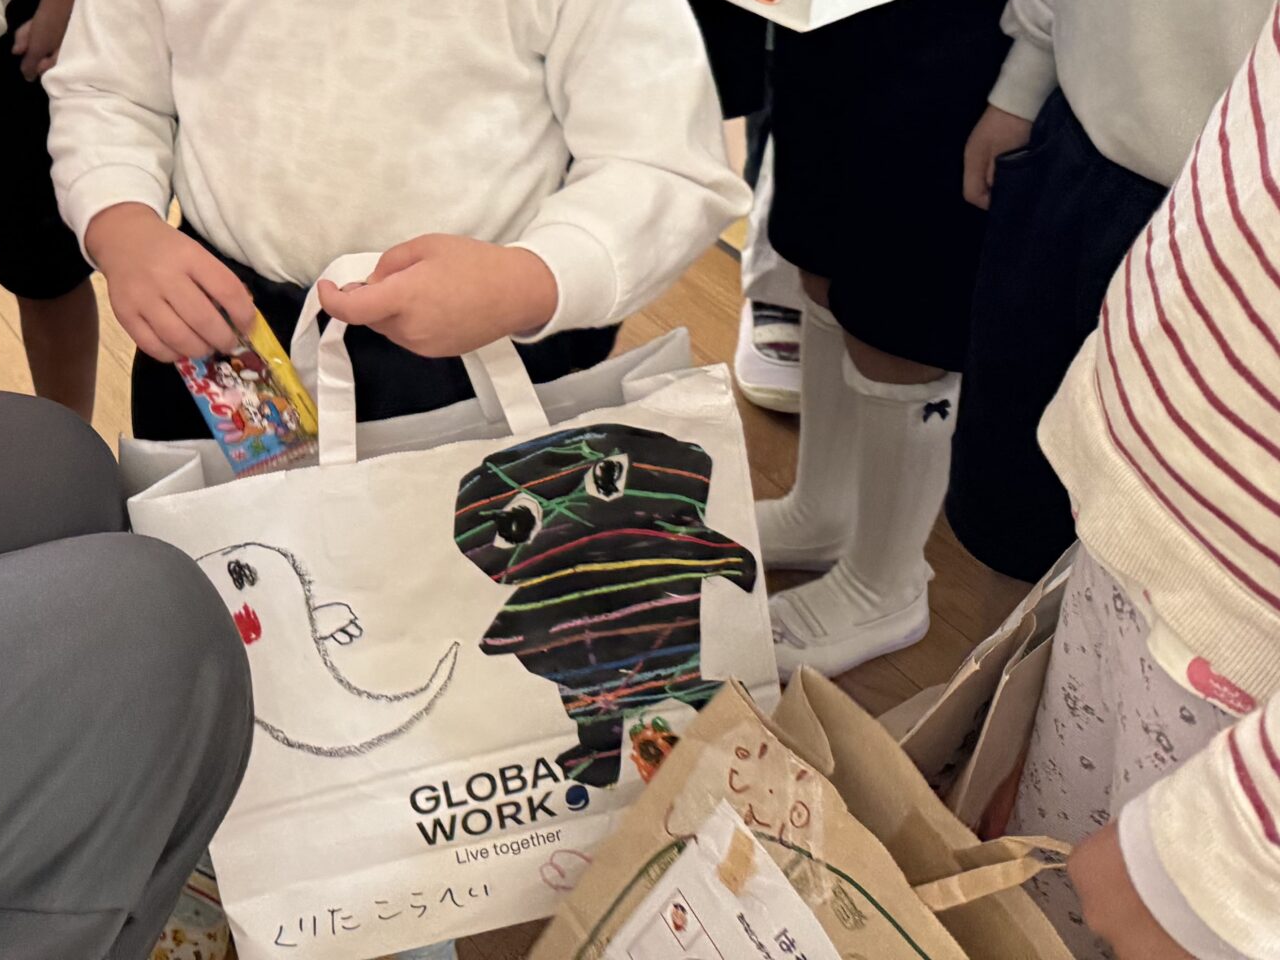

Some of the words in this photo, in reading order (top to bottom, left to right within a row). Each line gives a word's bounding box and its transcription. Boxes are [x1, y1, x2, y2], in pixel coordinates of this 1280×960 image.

[410, 757, 570, 814] GLOBA
[416, 791, 557, 845] WORK
[455, 847, 490, 865] Live
[494, 829, 562, 857] together
